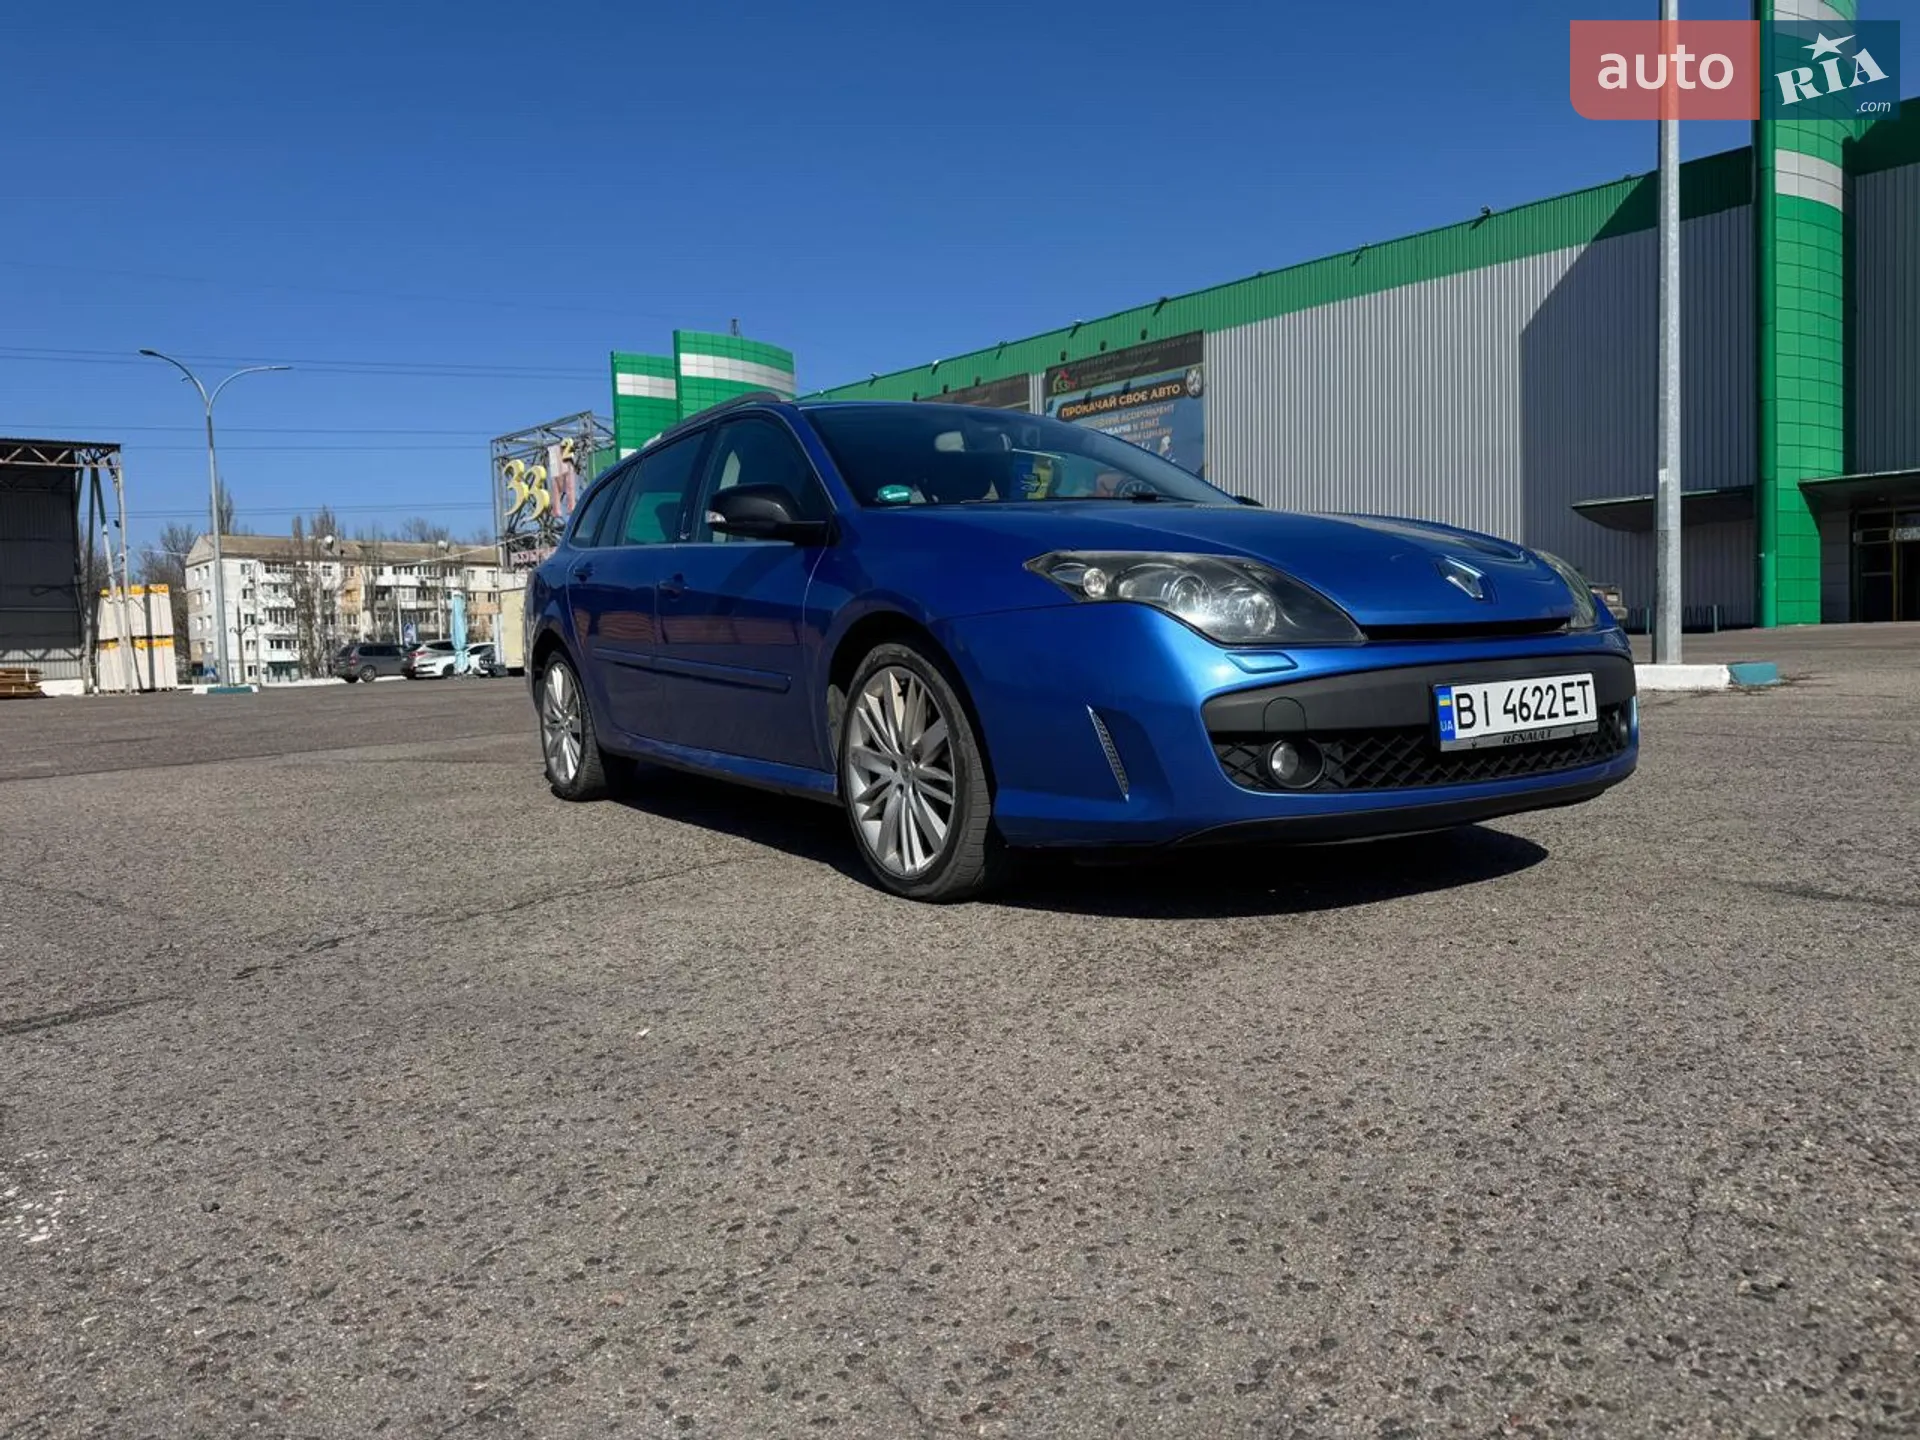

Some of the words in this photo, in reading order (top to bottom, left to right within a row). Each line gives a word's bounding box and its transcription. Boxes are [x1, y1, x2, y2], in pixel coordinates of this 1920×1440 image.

[1062, 395, 1117, 418] ПРОКАЧАЙ
[1118, 390, 1148, 406] СВОЄ
[1149, 383, 1181, 400] АВТО
[1455, 691, 1490, 730] BI
[1503, 684, 1560, 724] 4622
[1561, 680, 1590, 717] ET
[1440, 720, 1454, 732] UA
[1502, 730, 1552, 744] RENAULT
